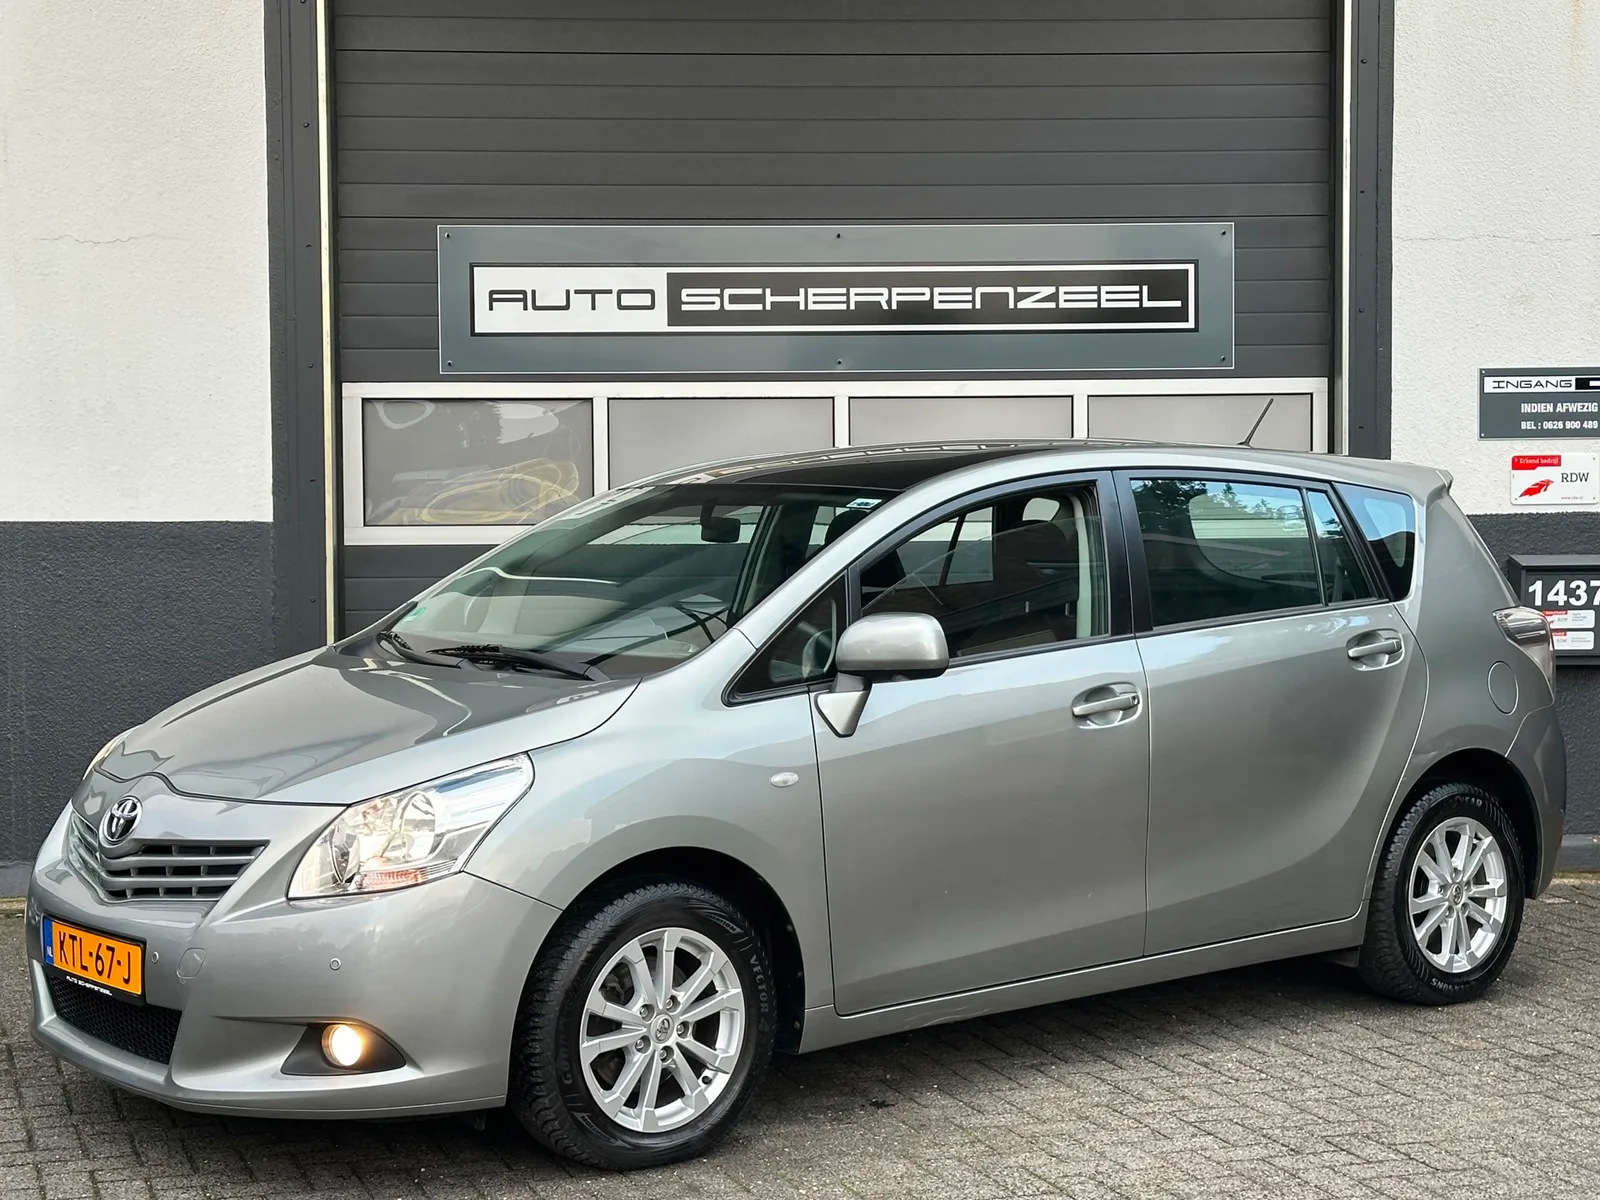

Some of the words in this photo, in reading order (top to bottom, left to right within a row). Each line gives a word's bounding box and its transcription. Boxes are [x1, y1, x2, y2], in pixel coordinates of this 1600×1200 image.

[488, 288, 656, 312] AUTO
[680, 284, 1182, 311] SCHERPENZEEL
[1492, 380, 1572, 389] INGANG
[1521, 403, 1553, 413] INDIEN
[1556, 402, 1598, 412] AFWEZIG
[1543, 421, 1563, 429] 0626
[1565, 421, 1580, 429] 900
[1583, 420, 1598, 429] 489
[1561, 472, 1589, 483] RDW
[1528, 580, 1600, 606] 1437
[58, 930, 131, 985] KTL-67-J
